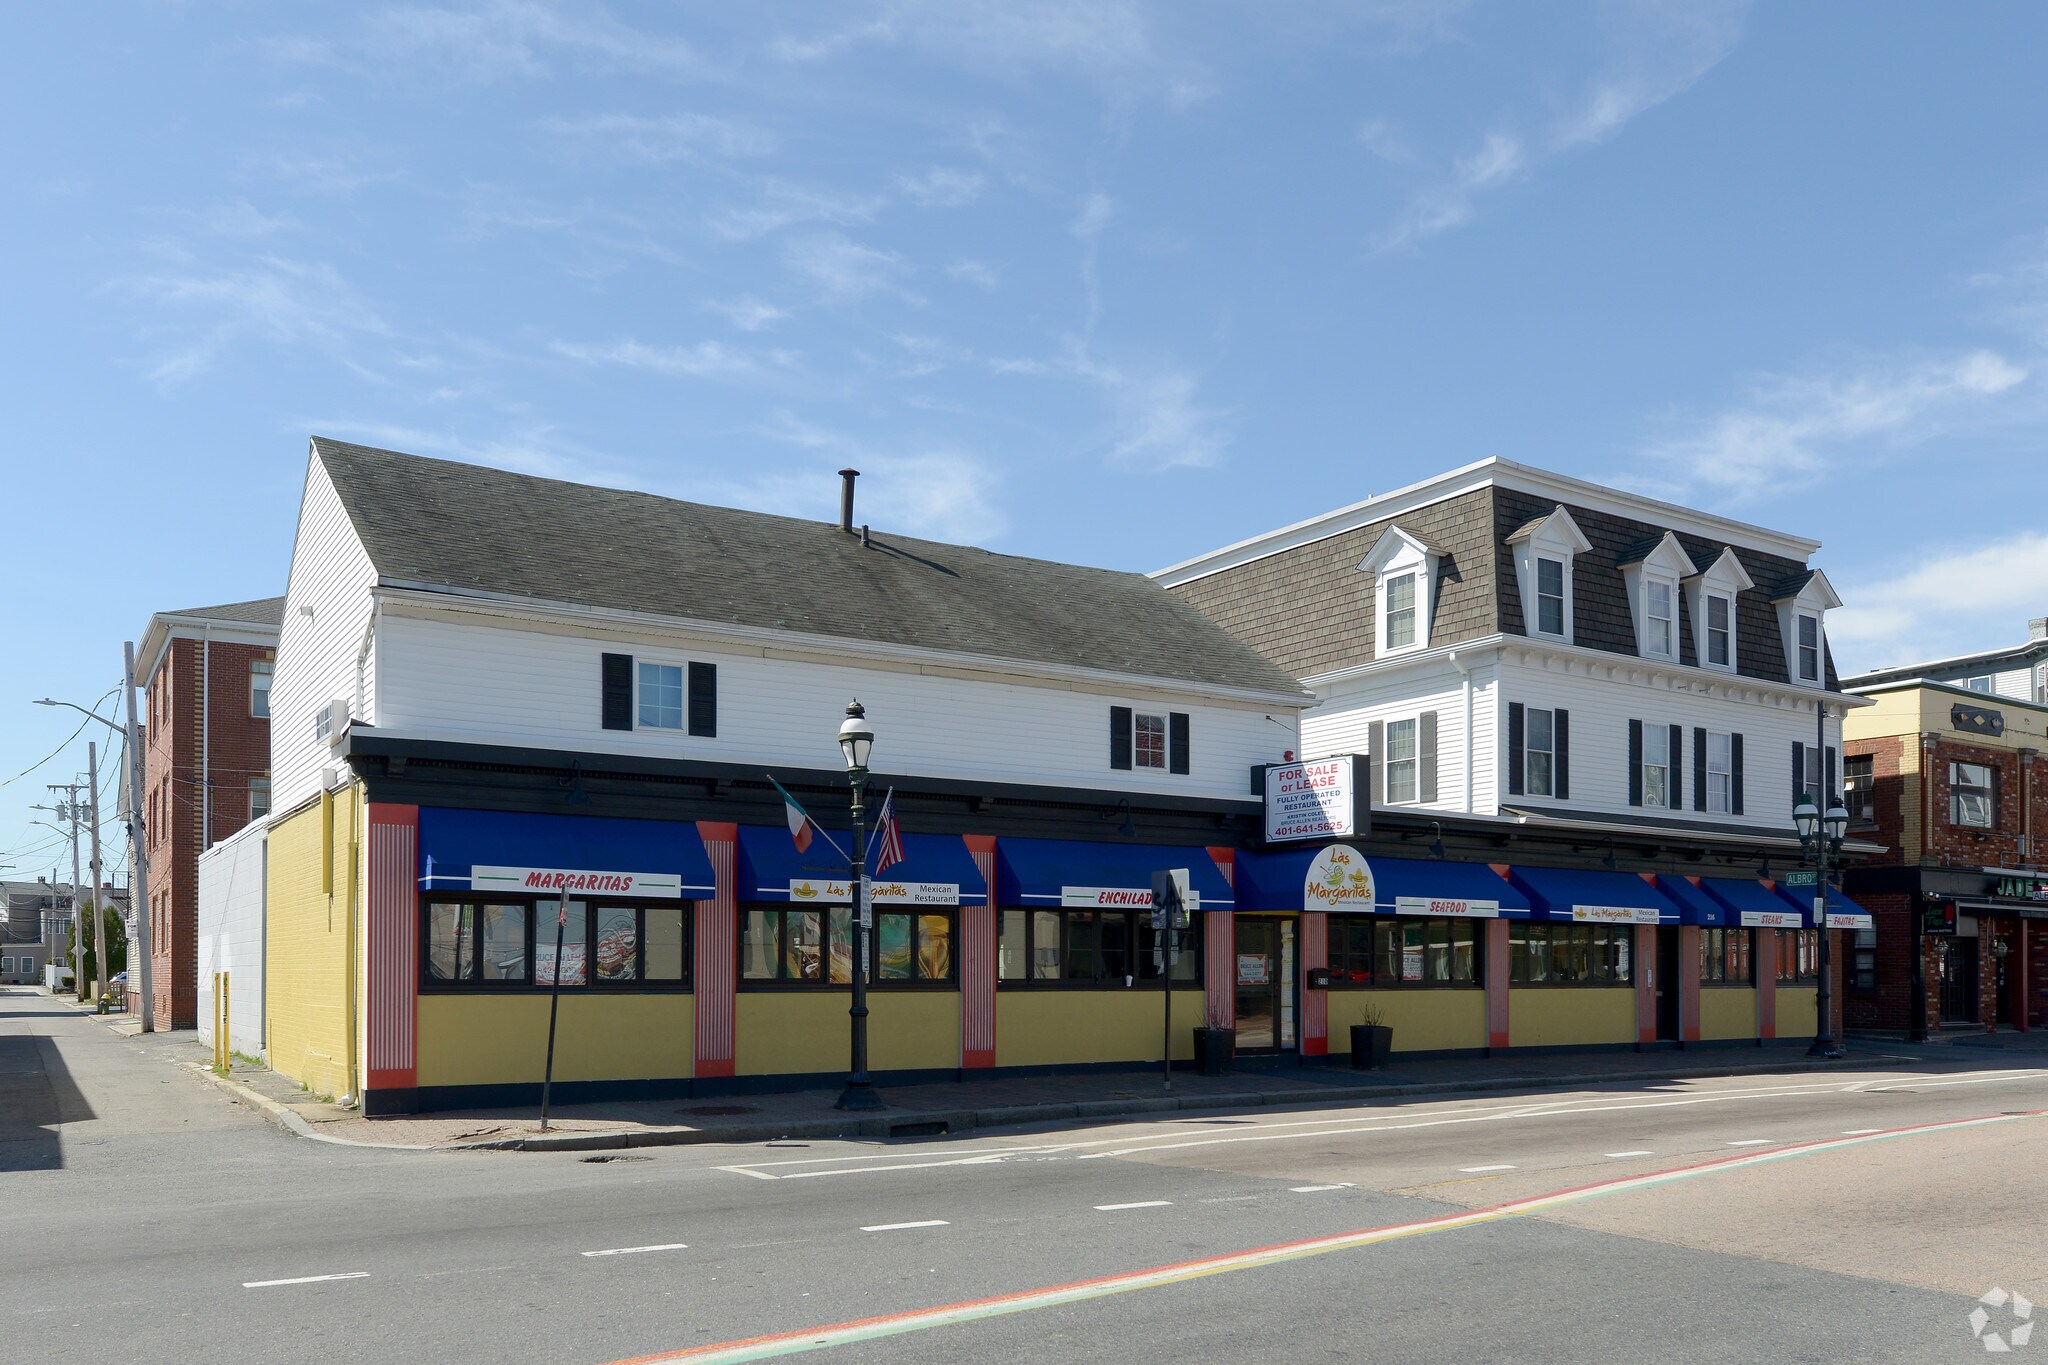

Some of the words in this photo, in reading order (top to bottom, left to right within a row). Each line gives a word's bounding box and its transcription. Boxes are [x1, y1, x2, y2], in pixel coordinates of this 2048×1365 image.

[1279, 770, 1302, 781] FOR
[1307, 764, 1338, 777] SALE
[1281, 784, 1293, 792] or
[1296, 776, 1336, 790] LEASE
[1277, 795, 1299, 804] FULLY
[1301, 790, 1340, 800] OPERATED
[1284, 799, 1332, 811] RESTAURANT
[1275, 821, 1343, 836] 401-641-5625
[1330, 848, 1350, 865] Las
[524, 872, 633, 892] MARGARITAS
[1788, 874, 1812, 884] ALBRO
[826, 882, 845, 897] Las
[848, 882, 908, 901] garitas
[920, 885, 952, 894] Mexican
[1308, 881, 1371, 905] Margaritas
[1997, 877, 2033, 898] JADE
[914, 894, 957, 903] Restaurant
[1098, 891, 1152, 905] ENCHILAD
[1430, 901, 1467, 913] SEAFOOD
[1591, 907, 1601, 918] Las
[1602, 908, 1632, 921] Margaritas
[1761, 914, 1783, 924] STEAKS
[1834, 916, 1855, 926] FAJITAS
